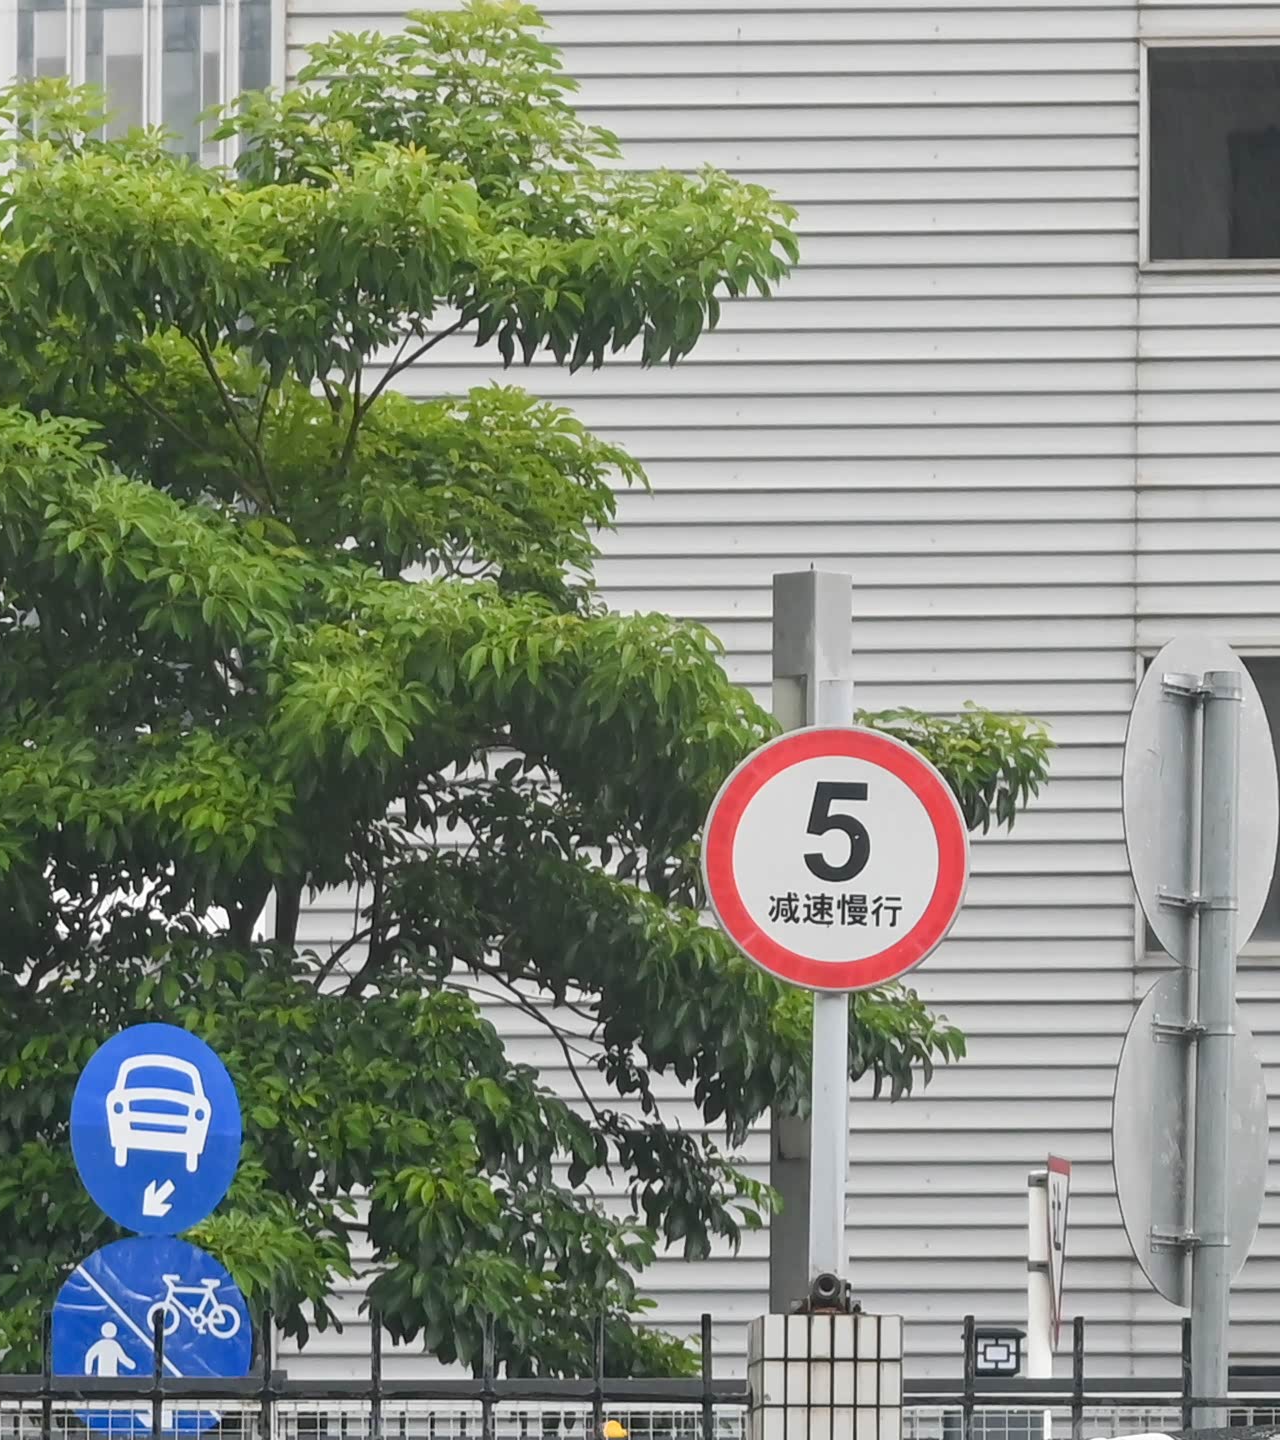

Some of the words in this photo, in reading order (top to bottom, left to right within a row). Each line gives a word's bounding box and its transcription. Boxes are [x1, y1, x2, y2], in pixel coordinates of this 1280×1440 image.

[803, 781, 871, 883] 5
[768, 892, 903, 928] 减速慢行
